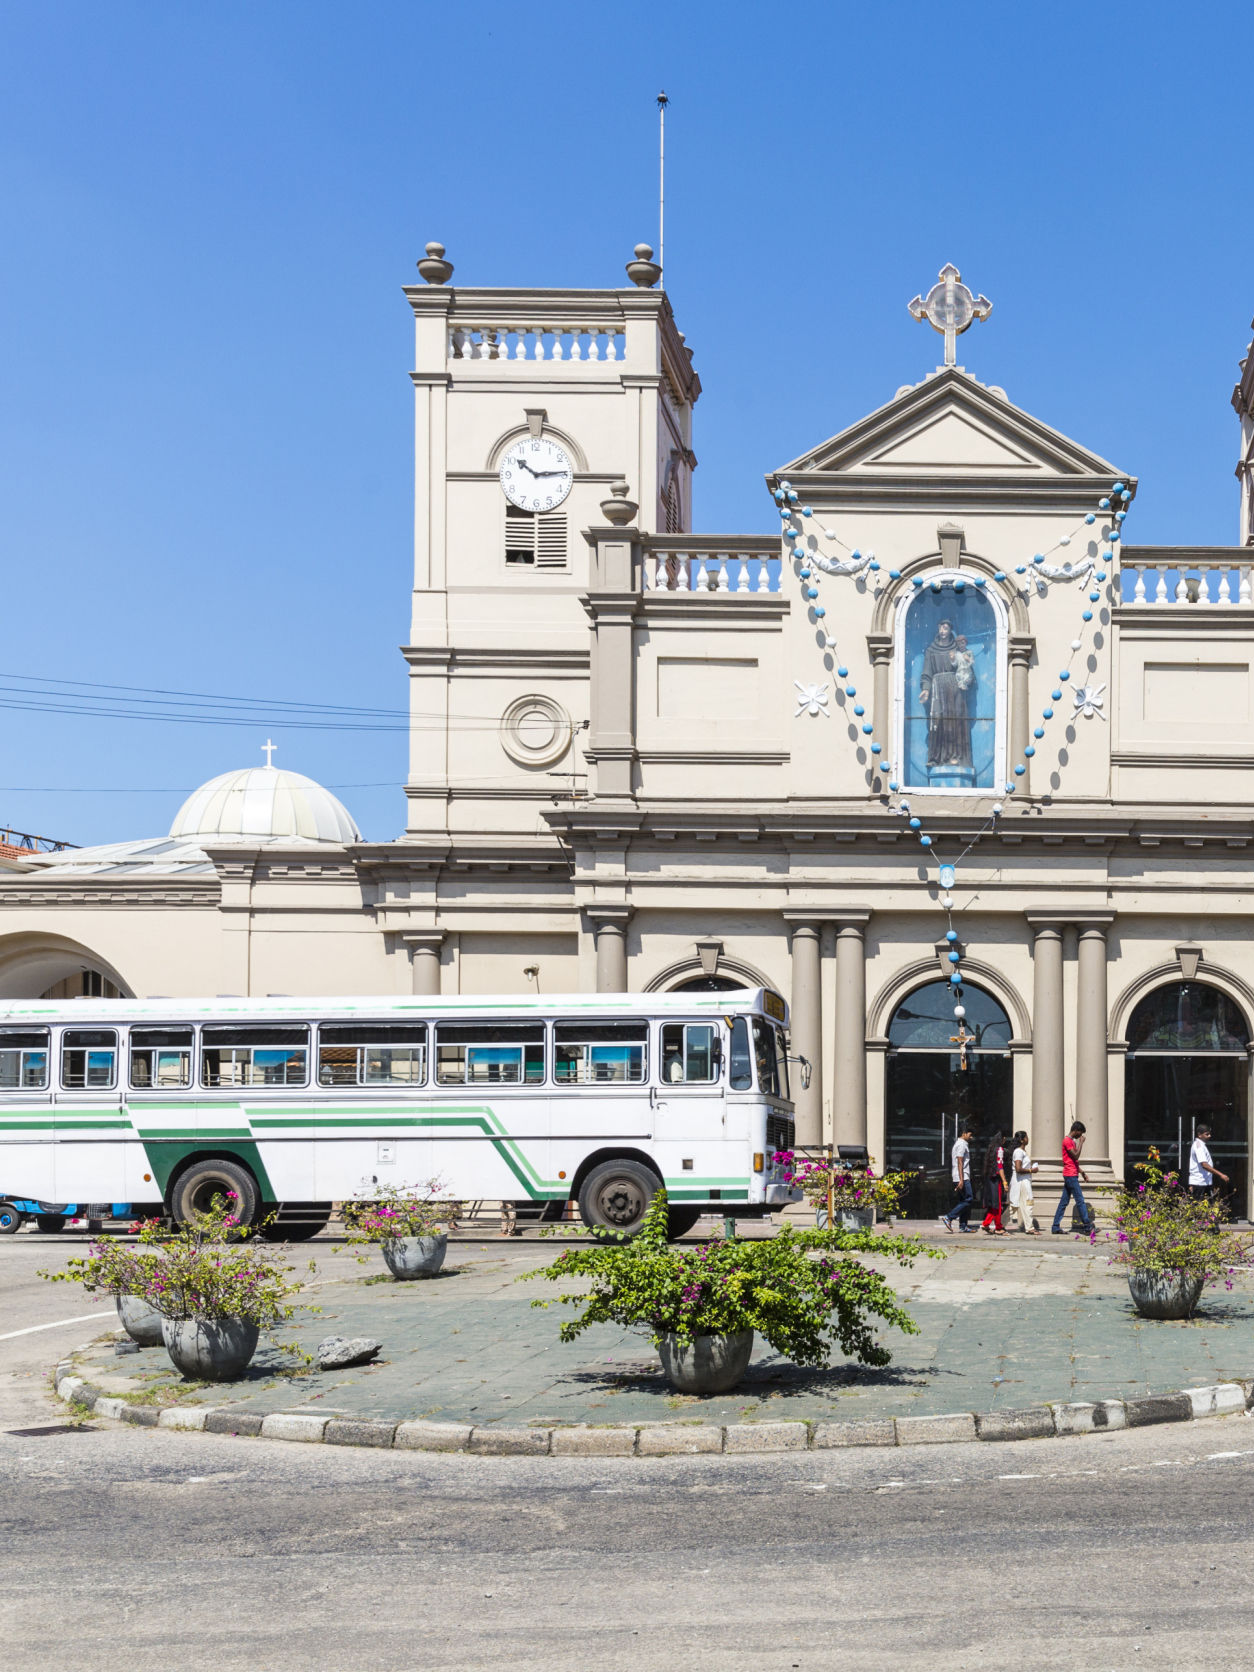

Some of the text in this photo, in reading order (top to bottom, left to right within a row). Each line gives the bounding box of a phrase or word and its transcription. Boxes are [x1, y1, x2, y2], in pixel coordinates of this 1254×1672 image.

[531, 442, 541, 452] 12
[507, 456, 517, 466] 10
[556, 453, 564, 463] 2
[504, 470, 512, 480] 9
[508, 484, 516, 494] 8
[555, 483, 563, 493] 4
[519, 495, 527, 504] 7
[532, 498, 540, 508] 6
[545, 495, 553, 505] 5
